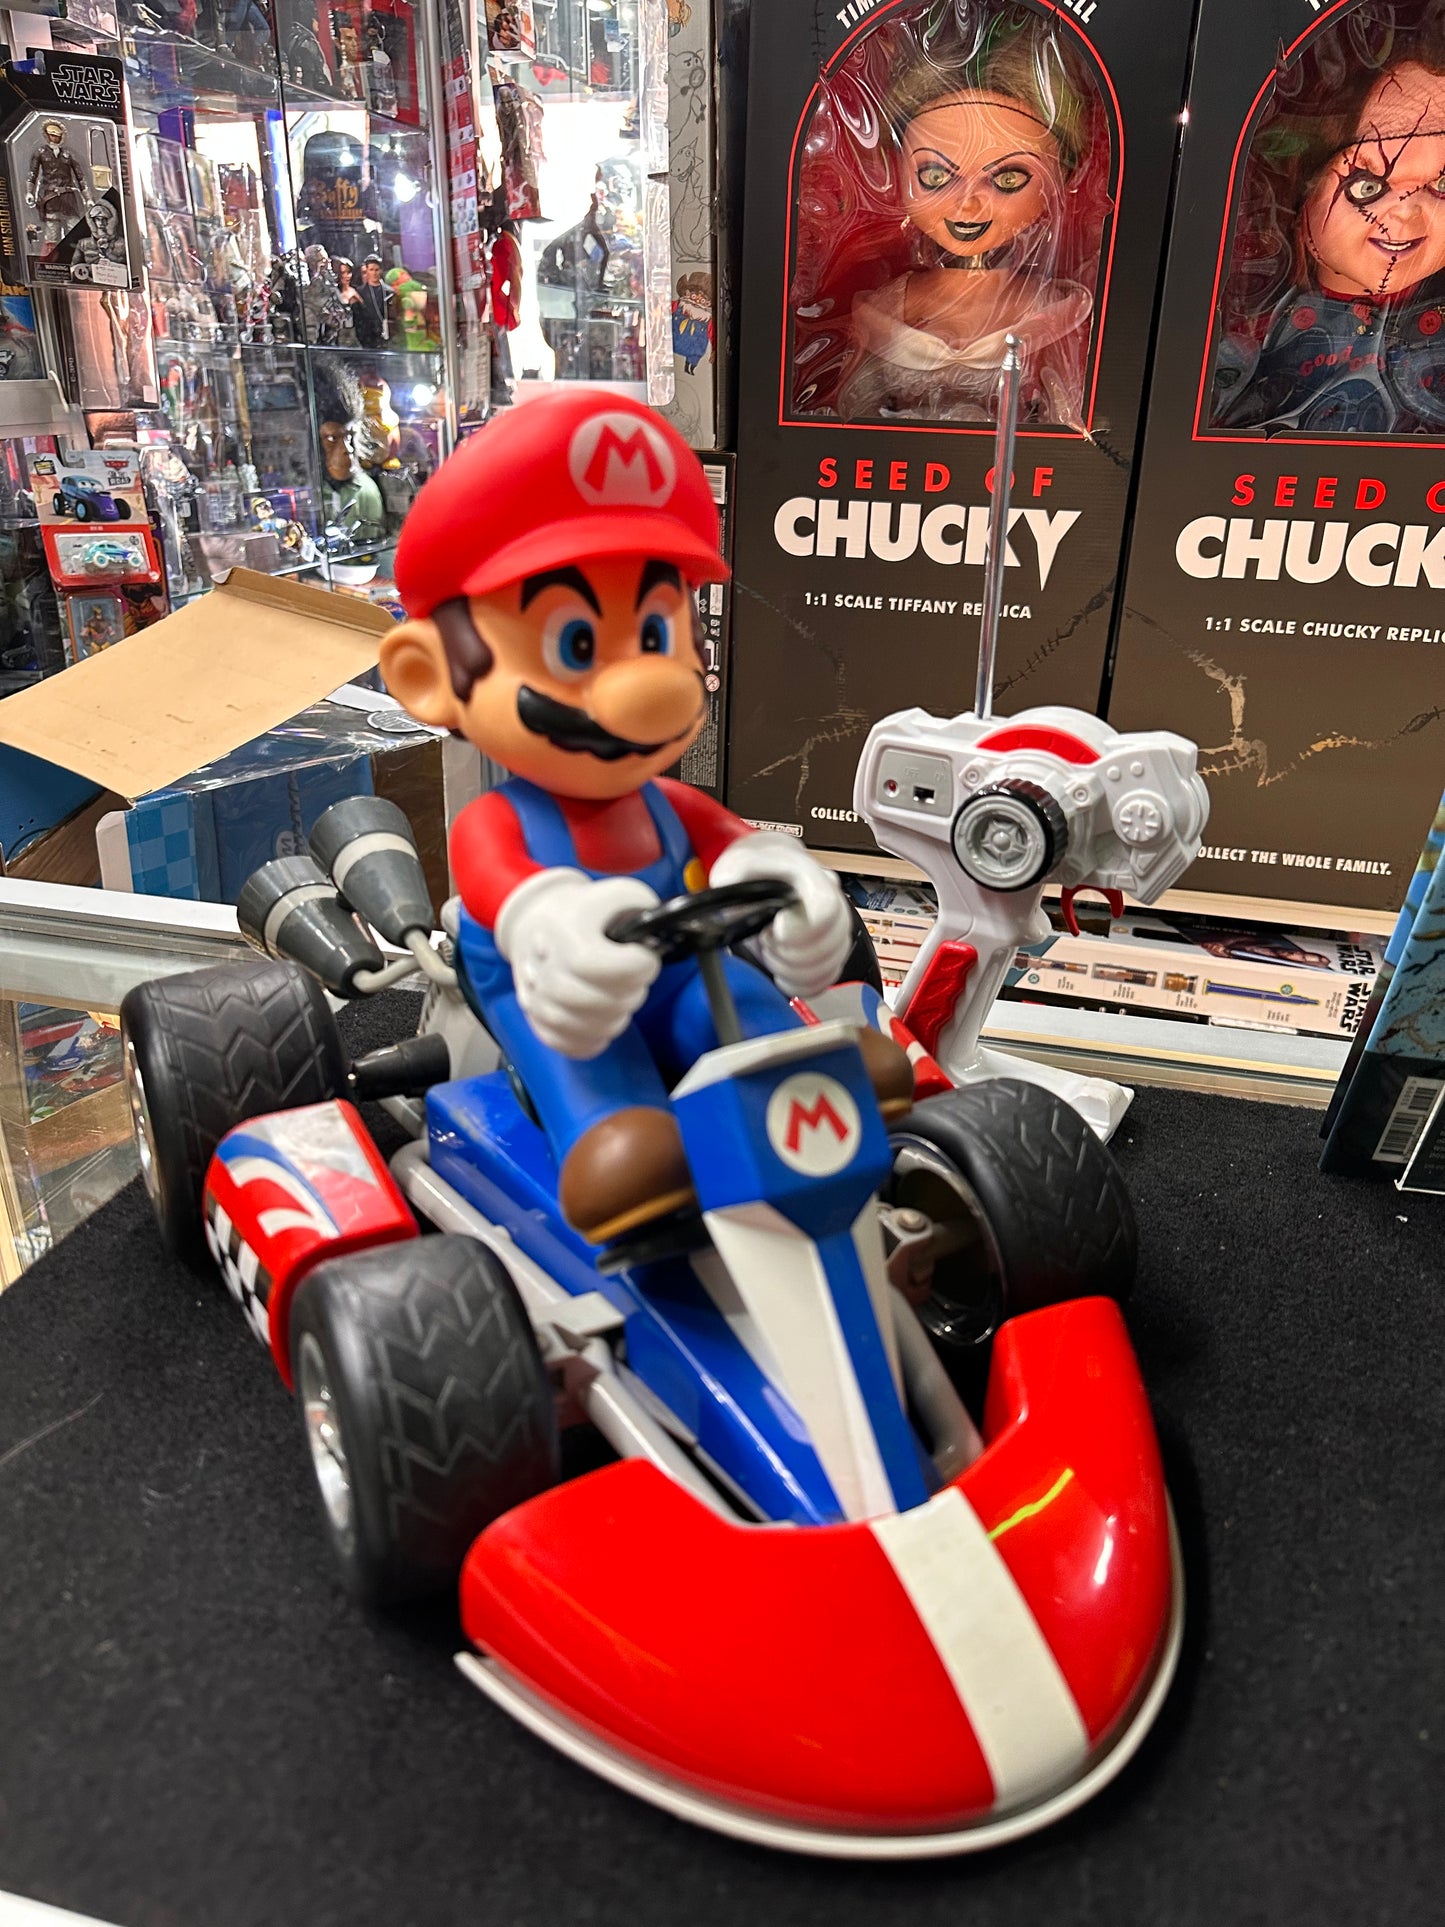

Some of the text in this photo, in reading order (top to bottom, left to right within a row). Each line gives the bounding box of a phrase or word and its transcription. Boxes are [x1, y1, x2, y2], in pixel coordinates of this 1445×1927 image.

[836, 0, 882, 29] TIM
[51, 63, 121, 86] STAR
[52, 80, 120, 103] WARS
[583, 423, 667, 494] M
[818, 457, 950, 492] SEED
[1231, 474, 1387, 510] SEED
[773, 497, 1082, 591] CHUCKY
[1175, 515, 1445, 589] CHUCK
[804, 592, 1032, 619] 1:1 SCALE TIFFANY REICA
[1204, 617, 1233, 631] 1:1
[1239, 618, 1297, 634] SCALE
[1302, 621, 1382, 640] CHUCKY
[810, 806, 859, 823] COLLECT
[1195, 846, 1392, 876] OLLECT THE WHOLE FAMILY.
[1336, 943, 1358, 976] WARS
[1353, 944, 1376, 977] STAR
[1339, 982, 1363, 1033] WARS
[784, 1093, 849, 1153] M
